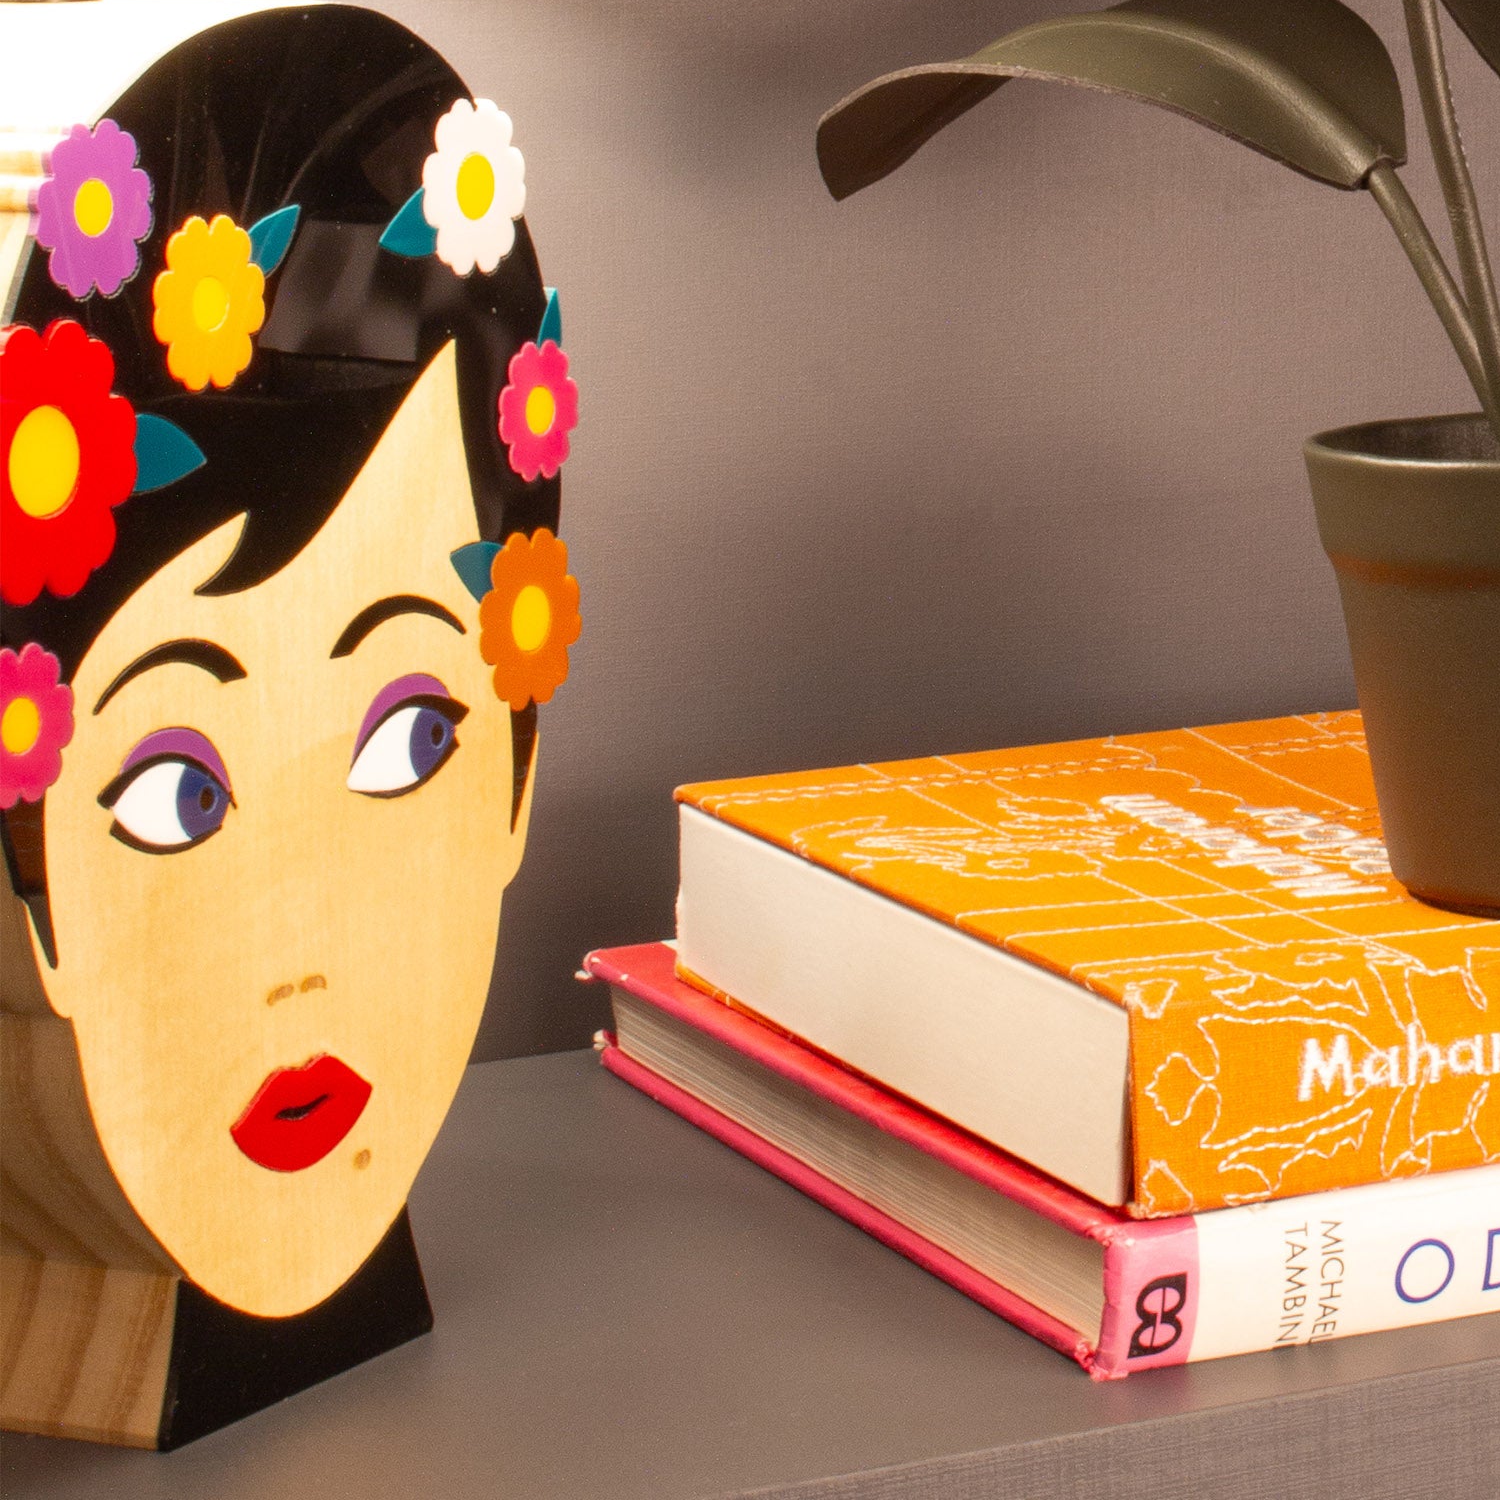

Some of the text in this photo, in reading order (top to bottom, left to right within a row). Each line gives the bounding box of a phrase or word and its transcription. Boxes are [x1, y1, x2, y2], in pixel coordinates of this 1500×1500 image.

[1100, 793, 1388, 898] Maharam
[1274, 1221, 1308, 1347] TAMBIN
[1308, 1220, 1345, 1344] MICHAEL
[1395, 1240, 1455, 1305] O
